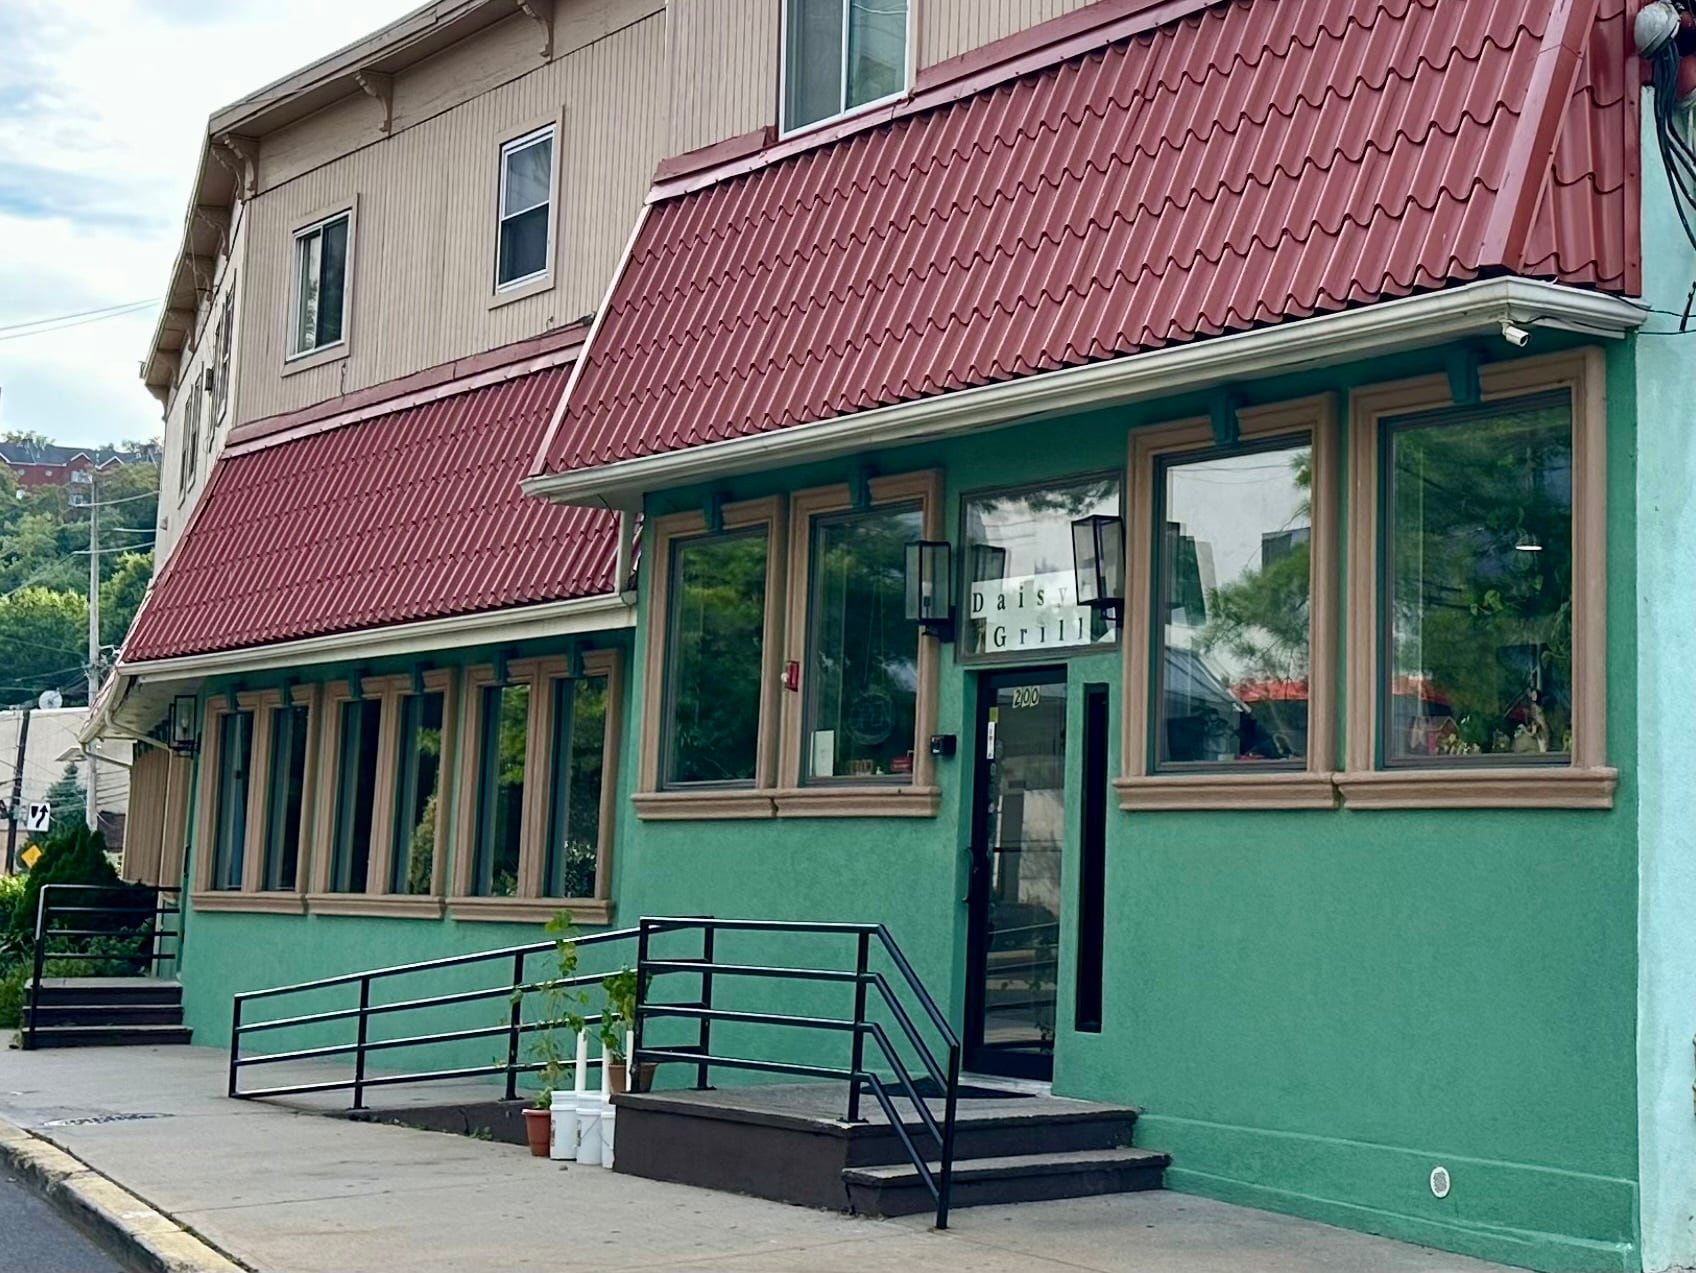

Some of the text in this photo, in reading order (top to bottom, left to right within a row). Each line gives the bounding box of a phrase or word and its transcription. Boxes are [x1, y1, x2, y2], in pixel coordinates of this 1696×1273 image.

[972, 585, 1068, 613] Daisy
[993, 617, 1083, 647] Grill
[1014, 687, 1039, 706] 200
